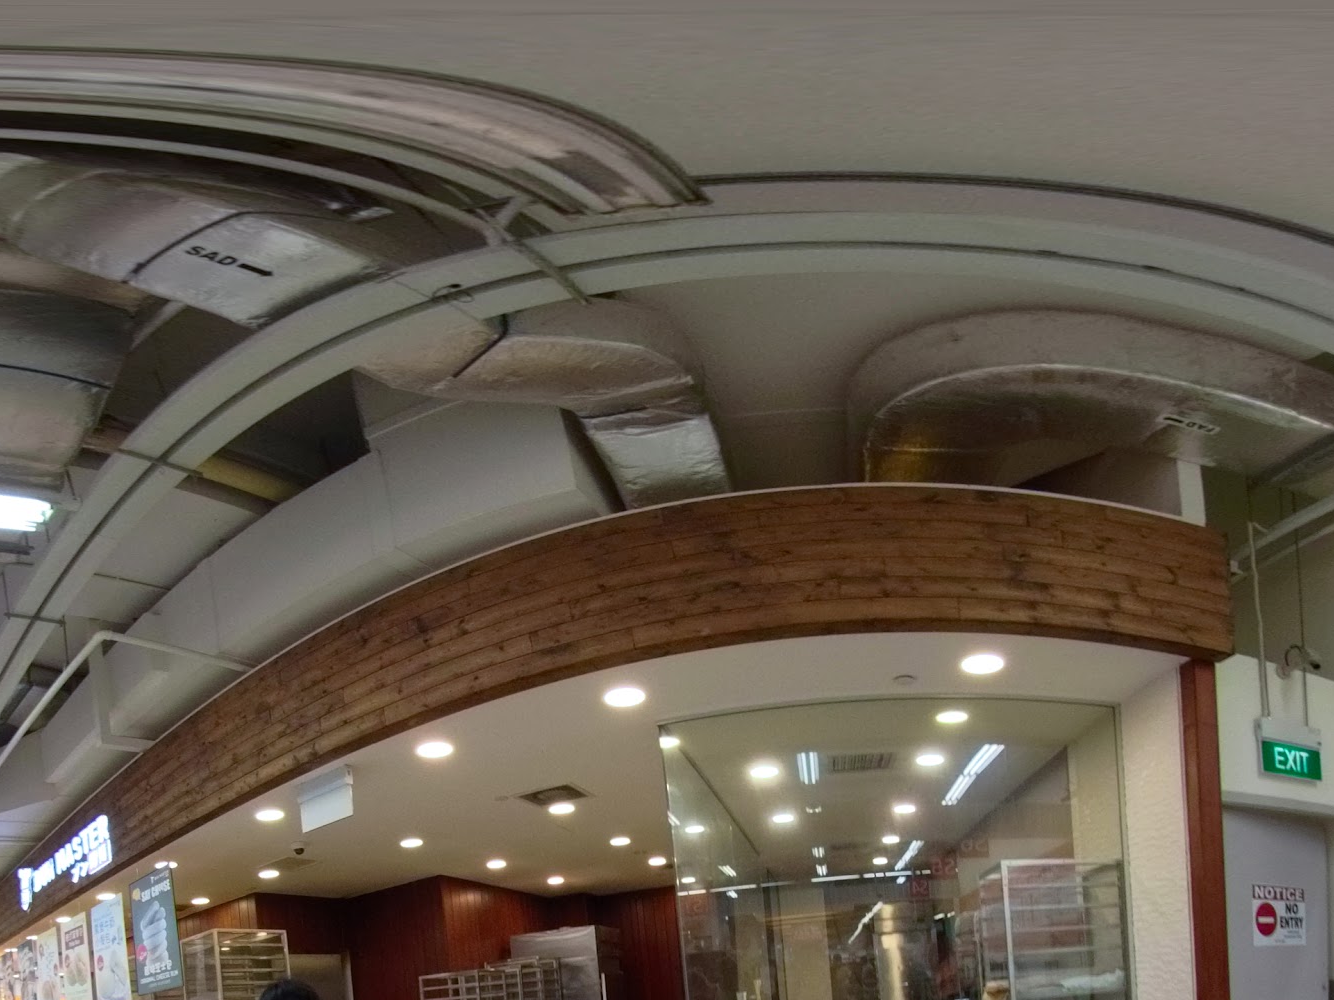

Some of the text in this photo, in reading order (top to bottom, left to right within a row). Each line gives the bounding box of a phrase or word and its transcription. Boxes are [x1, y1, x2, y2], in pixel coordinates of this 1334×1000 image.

[185, 243, 238, 269] SAD
[1274, 746, 1309, 774] EXIT
[1253, 885, 1304, 901] NOTICE
[1285, 903, 1299, 914] NO
[1280, 917, 1303, 930] ENTRY
